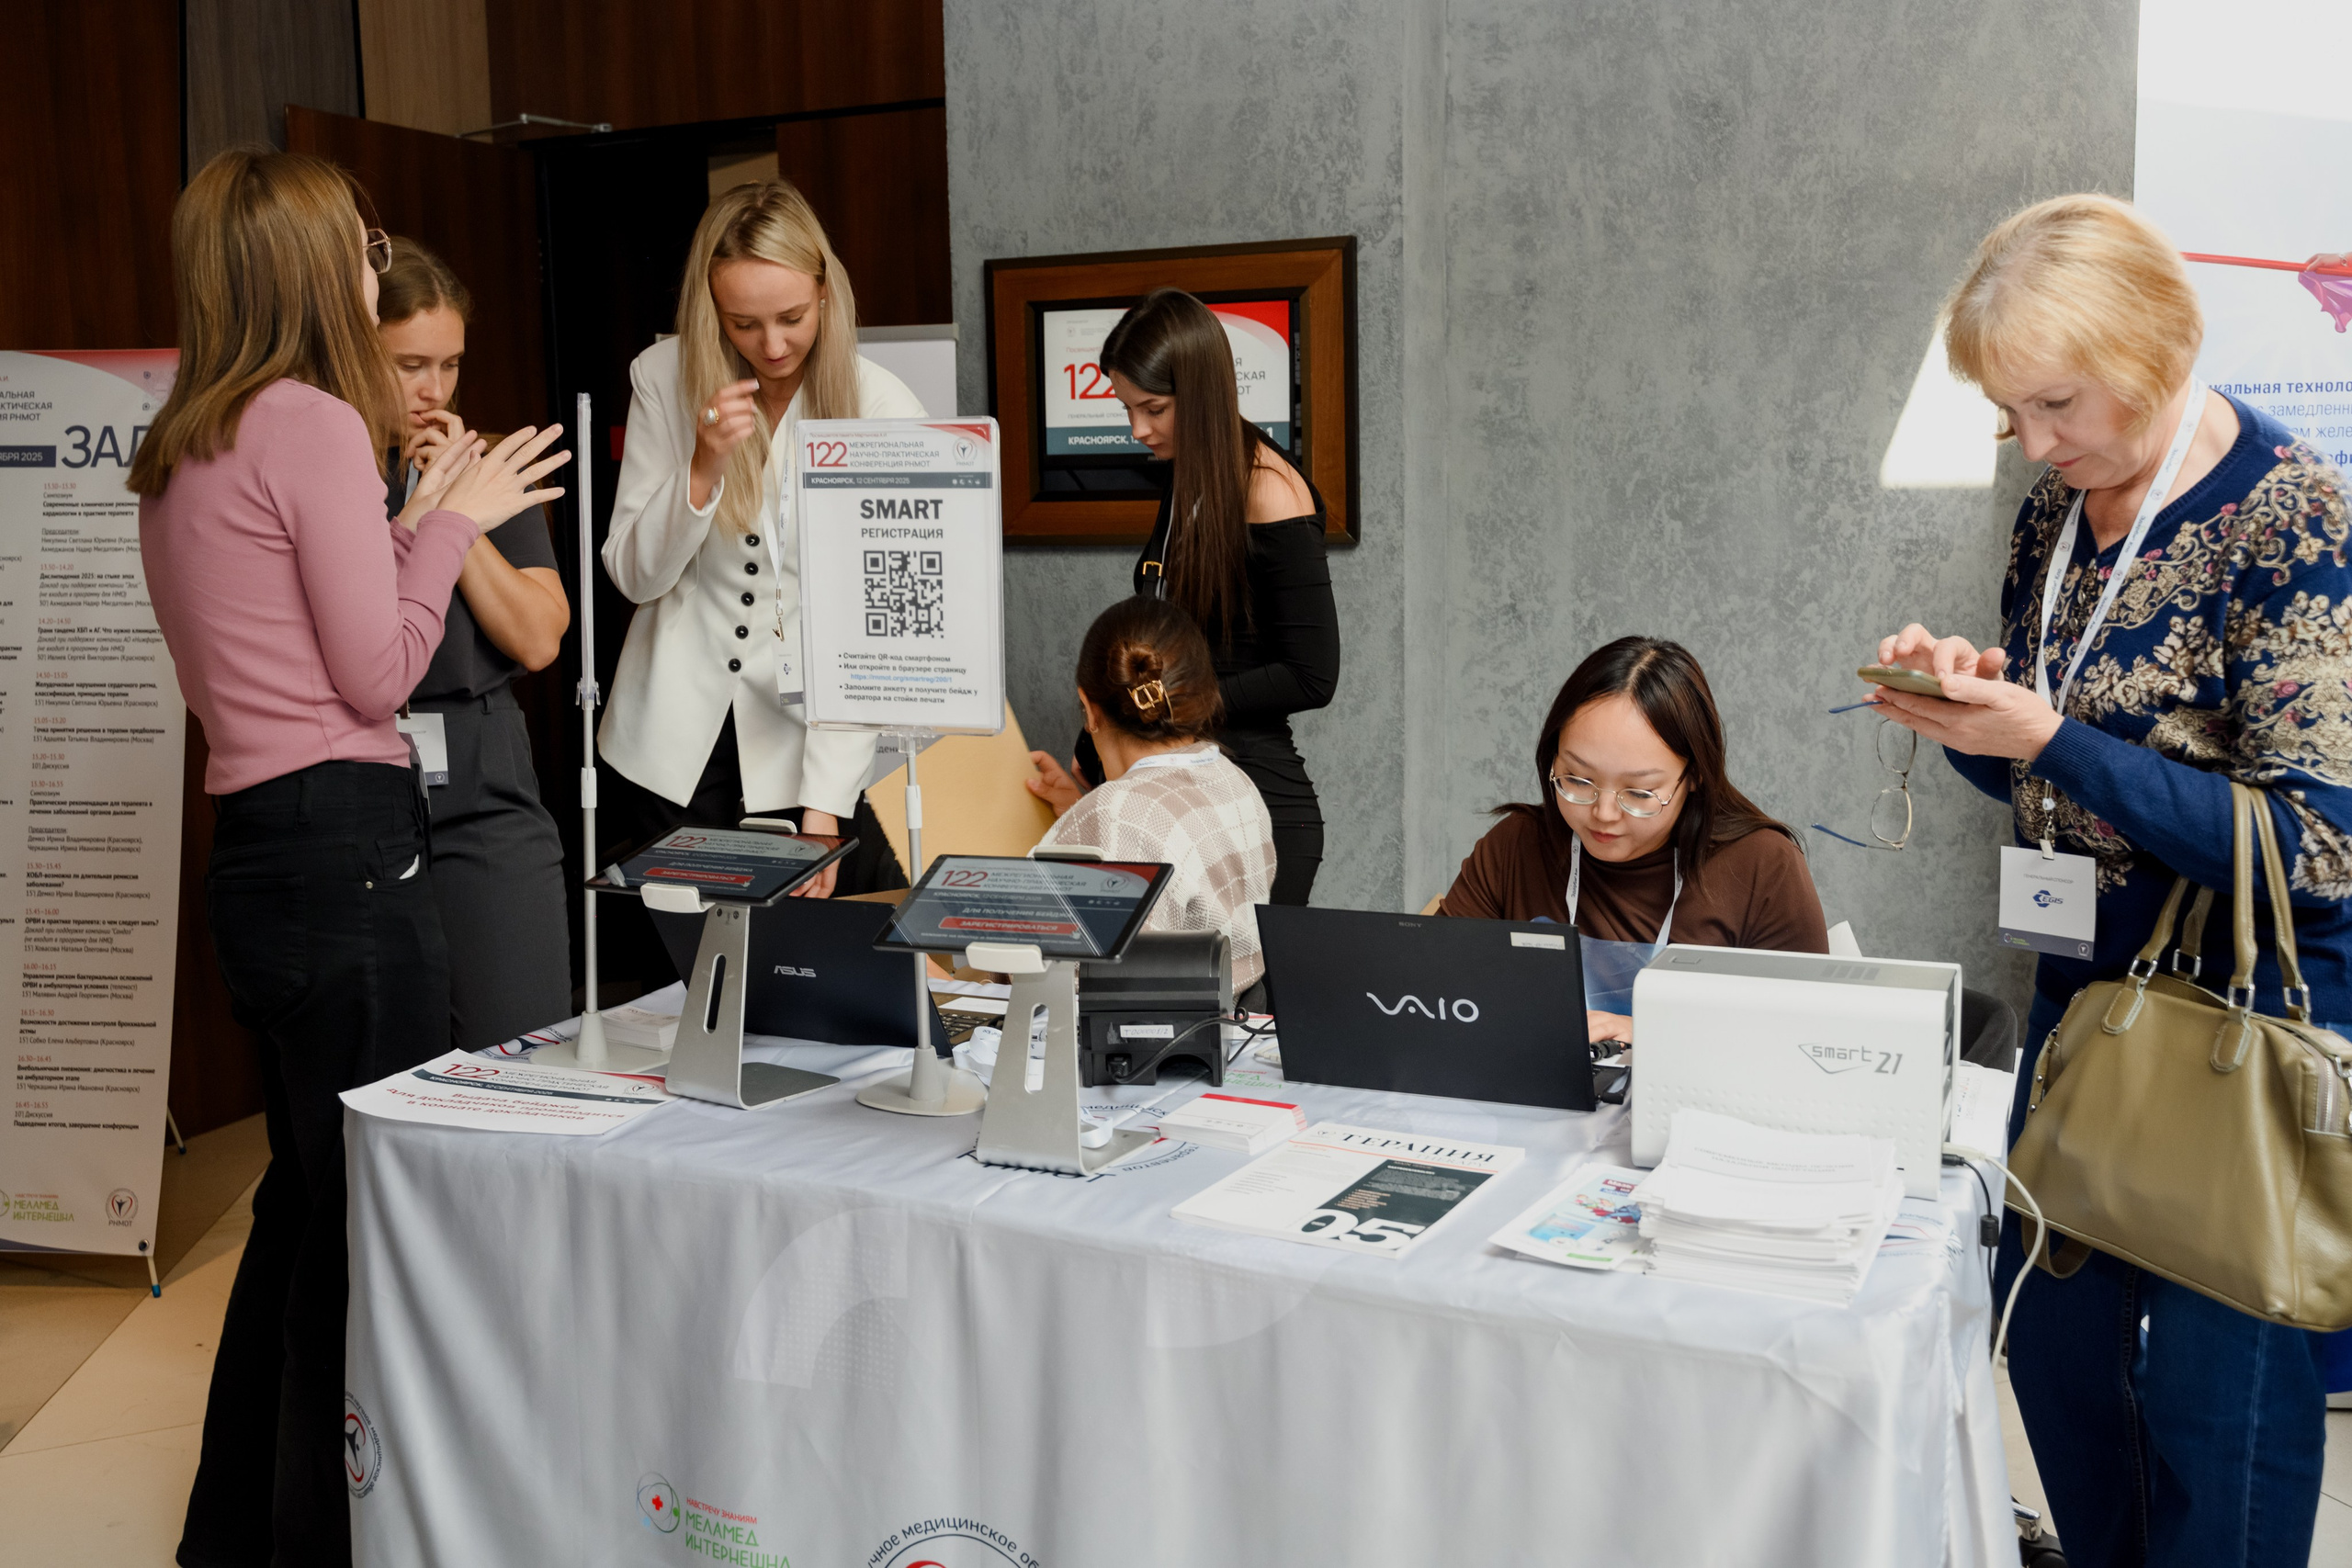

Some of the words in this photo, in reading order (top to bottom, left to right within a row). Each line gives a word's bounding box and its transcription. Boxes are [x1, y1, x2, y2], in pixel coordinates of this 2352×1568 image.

[1068, 435, 1128, 446] КРАСНОЯРСК,
[21, 452, 43, 461] 2025
[807, 442, 848, 467] 122
[860, 499, 943, 519] SMART
[861, 528, 943, 540] РЕГИСТРАЦИЯ
[843, 652, 876, 660] Считайте
[878, 653, 902, 661] QR-код
[904, 655, 950, 663] смартфоном
[899, 665, 931, 673] браузере
[933, 667, 967, 675] страницу
[844, 683, 881, 692] Заполните
[915, 686, 946, 694] получите
[949, 687, 972, 695] бейдж
[665, 836, 707, 848] 122
[942, 870, 989, 887] 122
[2042, 896, 2064, 904] EGIS
[774, 965, 816, 978] ASUS
[1366, 992, 1479, 1022] VAIO
[1813, 1045, 1871, 1062] smart
[1874, 1052, 1903, 1075] 21
[1343, 1134, 1496, 1163] ТЕРАПИЯ
[14, 1200, 59, 1211] МЕЛАМЕД
[686, 1497, 720, 1516] НАВСТРЕЧУ
[721, 1508, 757, 1524] ЗНАНИЯМ
[685, 1510, 759, 1547] МЕЛАМЕД
[902, 1517, 1017, 1552] медицинское
